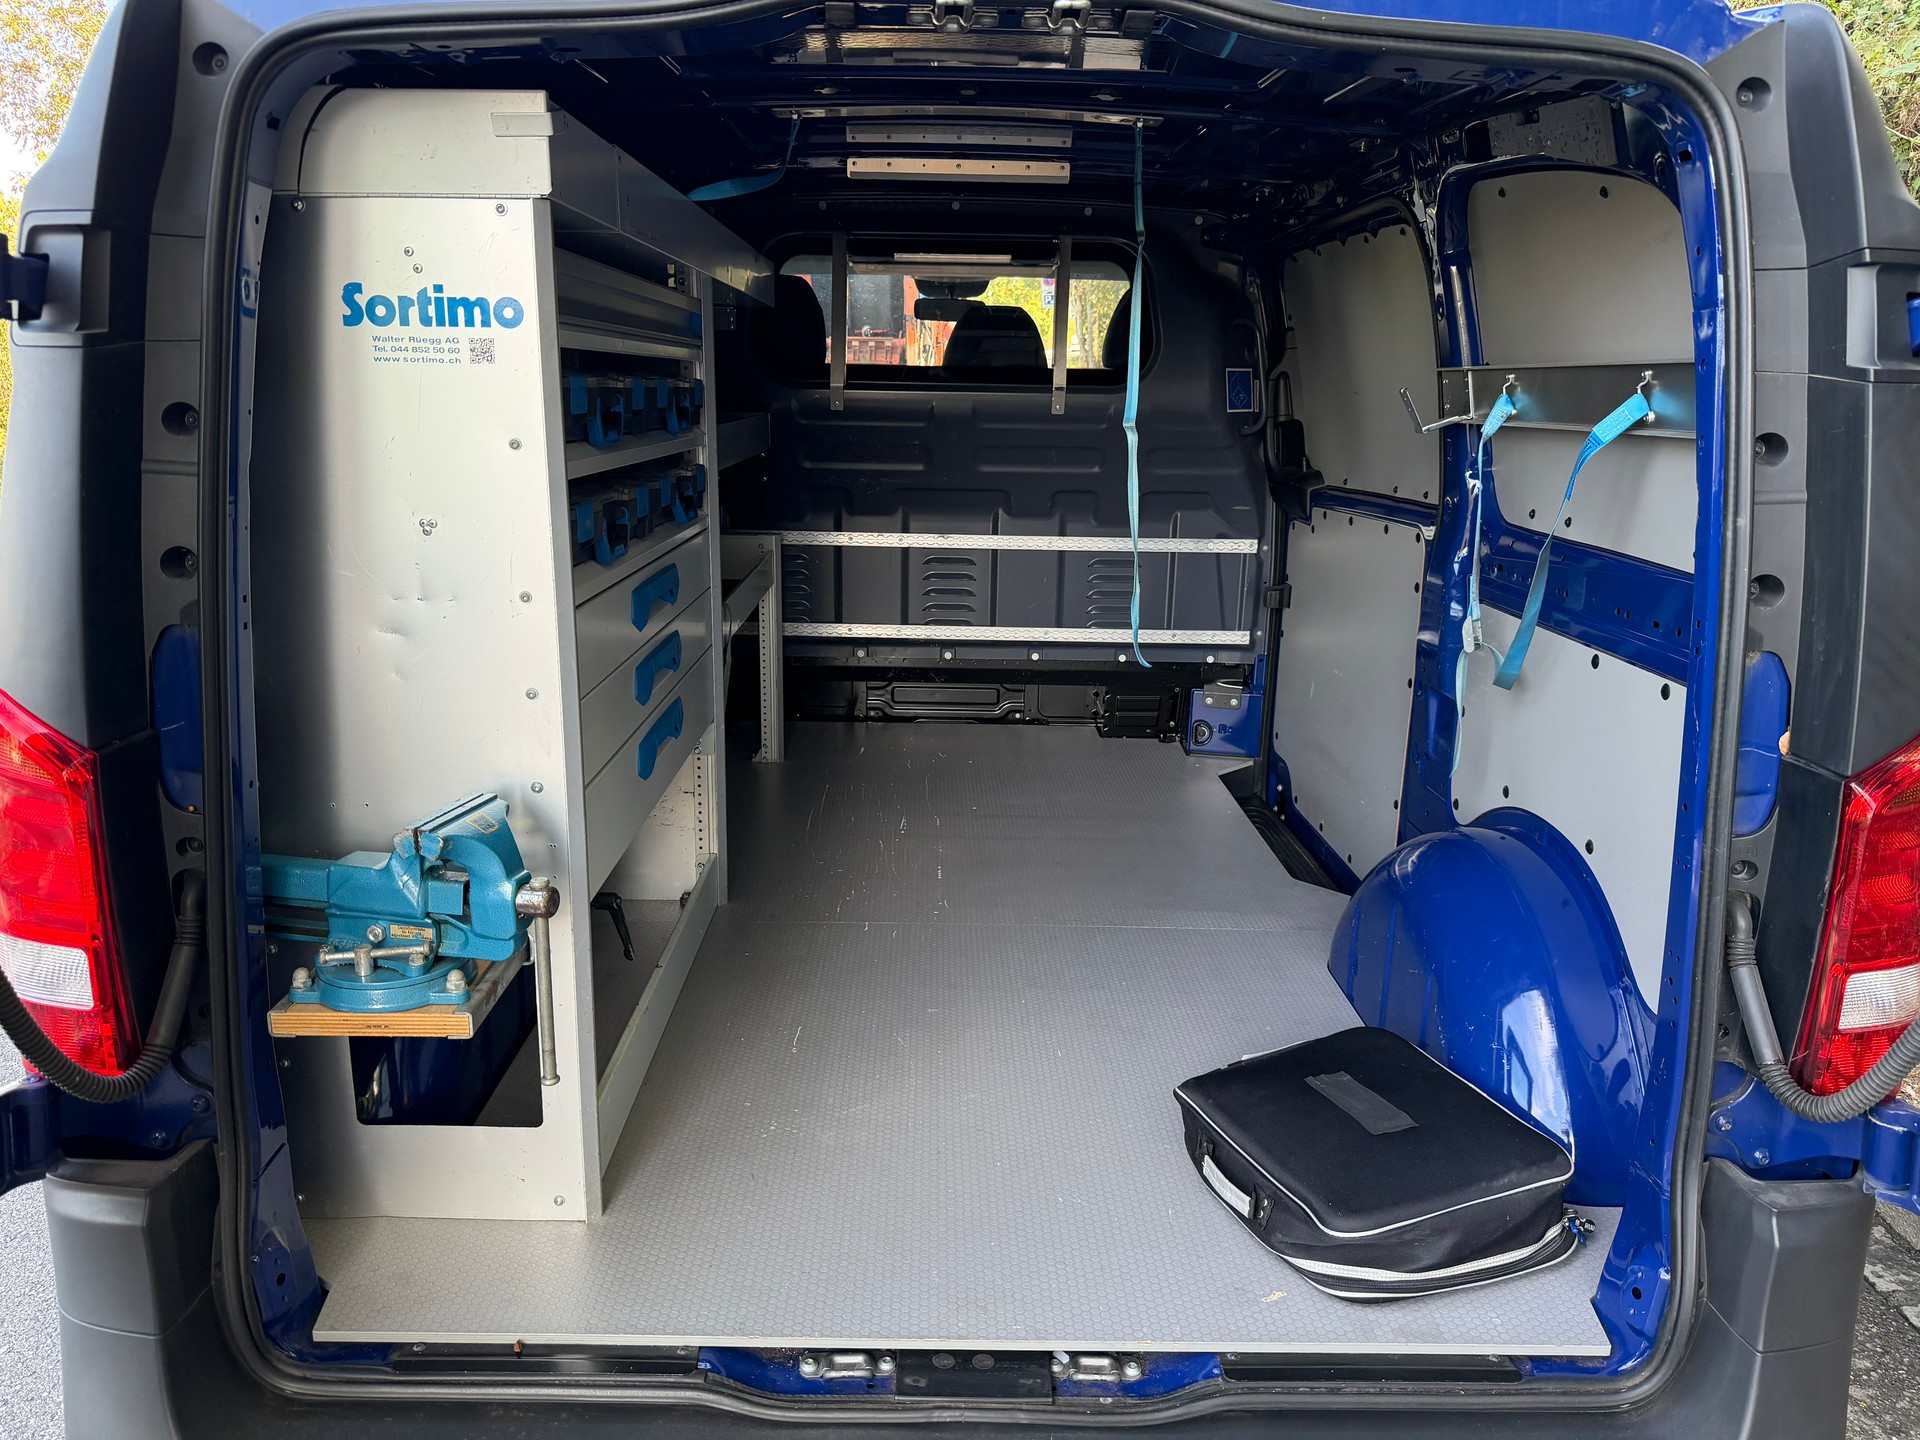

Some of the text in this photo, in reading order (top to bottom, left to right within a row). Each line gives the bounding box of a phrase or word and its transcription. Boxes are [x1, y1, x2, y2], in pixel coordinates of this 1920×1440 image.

[341, 281, 525, 330] Sortimo
[371, 335, 460, 346] Walter Rüegg AG
[372, 345, 461, 355] Tel. 044 852 50 60
[373, 355, 462, 365] wwwsortimo.ch
